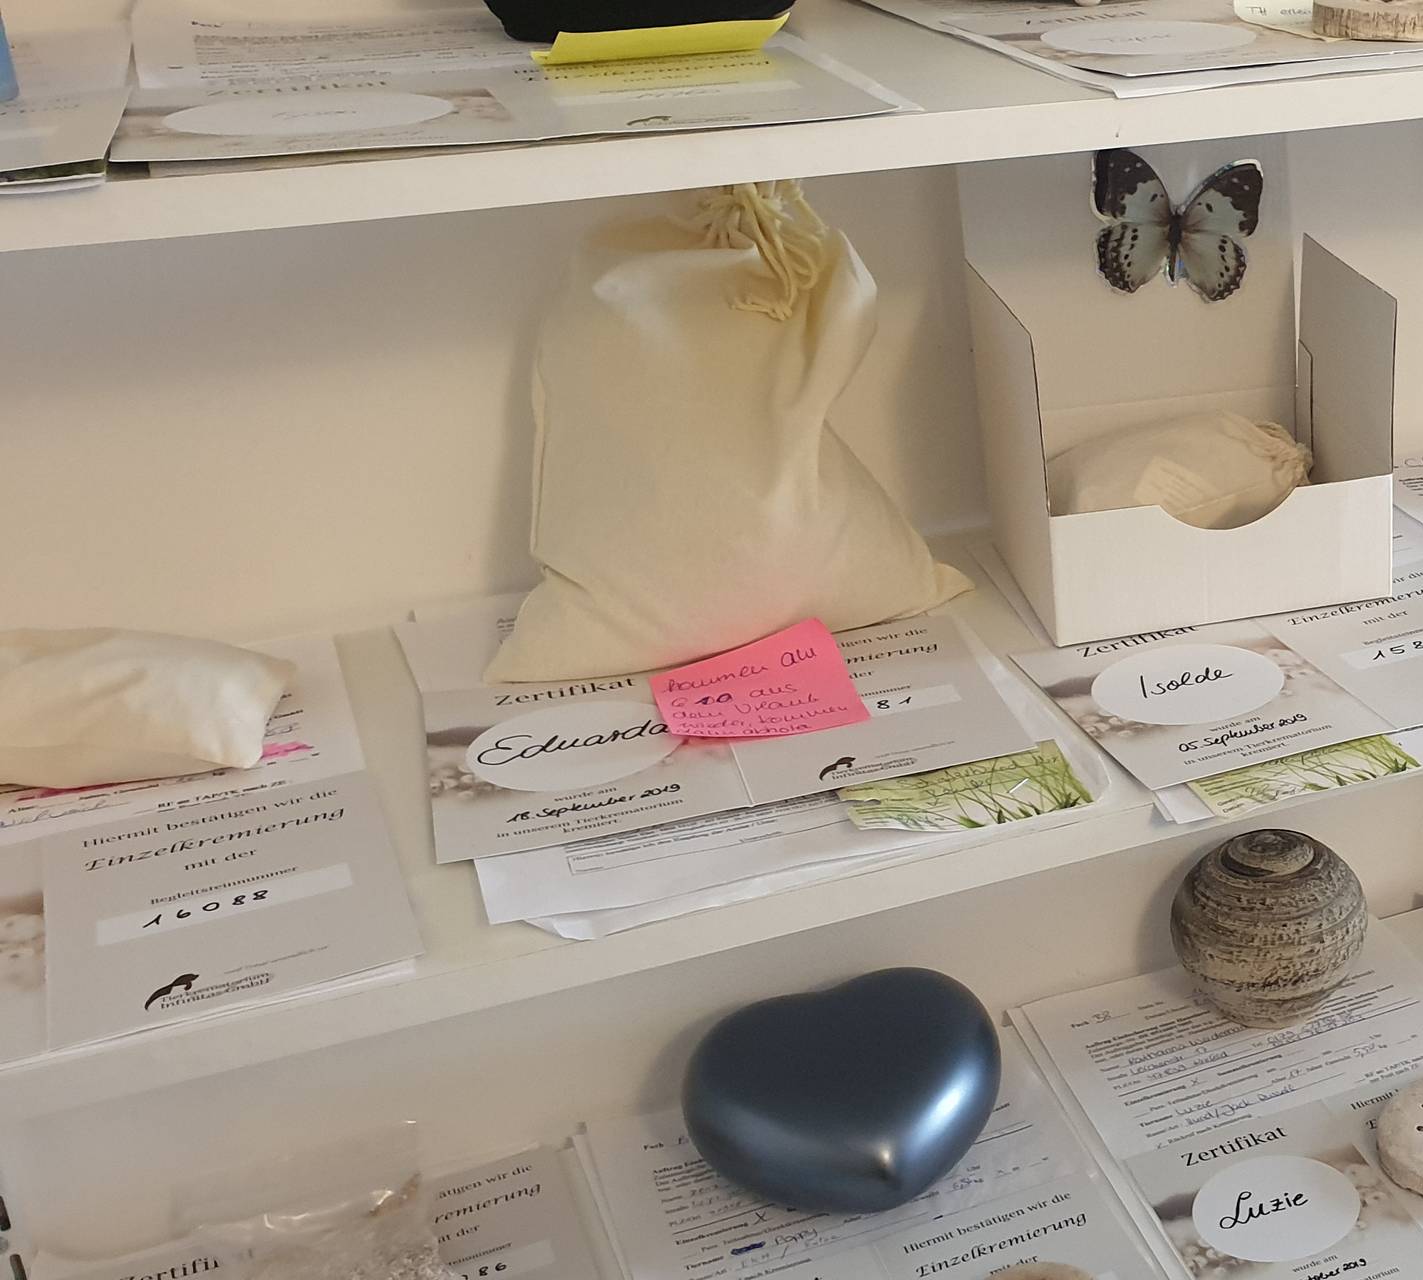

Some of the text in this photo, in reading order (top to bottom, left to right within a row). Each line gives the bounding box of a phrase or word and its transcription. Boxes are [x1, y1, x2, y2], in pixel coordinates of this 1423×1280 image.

[1387, 609, 1409, 620] der
[878, 626, 928, 644] wir die
[1077, 626, 1200, 658] Zertifikat
[494, 677, 637, 707] Zertifikat
[1140, 666, 1234, 699] Isolde
[1203, 722, 1276, 748] September
[1278, 713, 1308, 728] 2019
[1209, 715, 1261, 733] wurde am
[1243, 724, 1333, 752] Tierkrematorium
[477, 719, 670, 766] Eduarda
[535, 793, 637, 820] September
[640, 783, 682, 800] 2019
[554, 786, 618, 803] wurde am
[82, 787, 338, 850] Hiermit bestätigen wir die
[496, 799, 685, 840] in unserem Tierkrematorium
[84, 806, 345, 872] Einzelkremierung
[184, 847, 258, 872] mit der
[150, 865, 298, 906] Begleitsteinnummer
[142, 888, 269, 929] 16088
[1181, 1126, 1289, 1168] Zertifikat
[485, 1163, 533, 1185] wir die
[903, 1191, 1072, 1255] Hiermit bestätigen wir die
[1219, 1190, 1311, 1231] Luzie
[456, 1223, 481, 1241] der
[915, 1211, 1088, 1278] Einzelkremierung
[1292, 1254, 1339, 1274] wurde am
